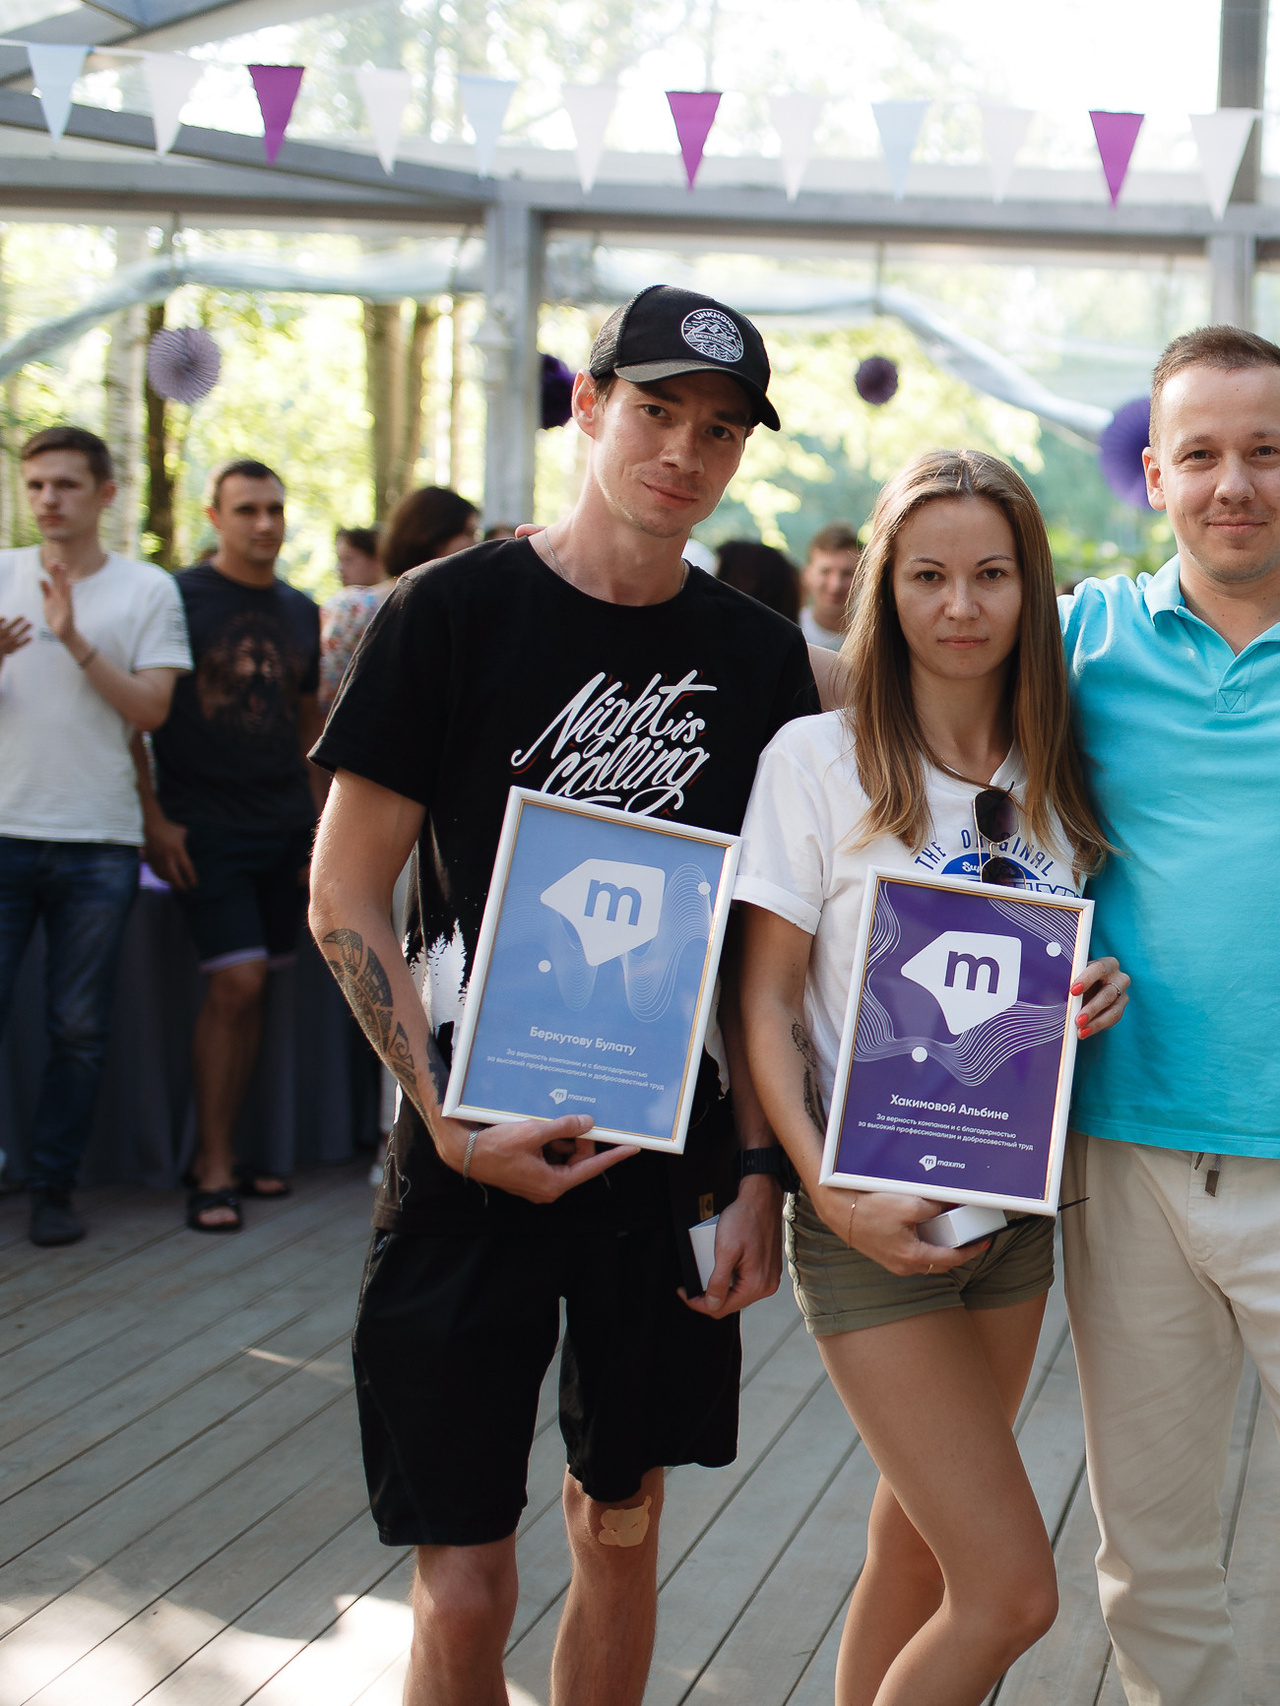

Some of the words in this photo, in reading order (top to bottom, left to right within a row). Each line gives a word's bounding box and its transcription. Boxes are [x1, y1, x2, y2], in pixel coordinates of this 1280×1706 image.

[693, 312, 736, 333] UNKNOWN
[510, 669, 718, 766] Night
[669, 711, 706, 744] is
[914, 841, 947, 870] THE
[584, 879, 642, 926] m
[944, 950, 1000, 994] m
[530, 1026, 592, 1048] Беркутову
[595, 1038, 636, 1056] Булату
[886, 1115, 916, 1126] верность
[890, 1094, 956, 1113] Хакимовой
[958, 1104, 1009, 1121] Альбине
[1018, 1143, 1034, 1151] труд
[938, 1160, 965, 1169] maxima
